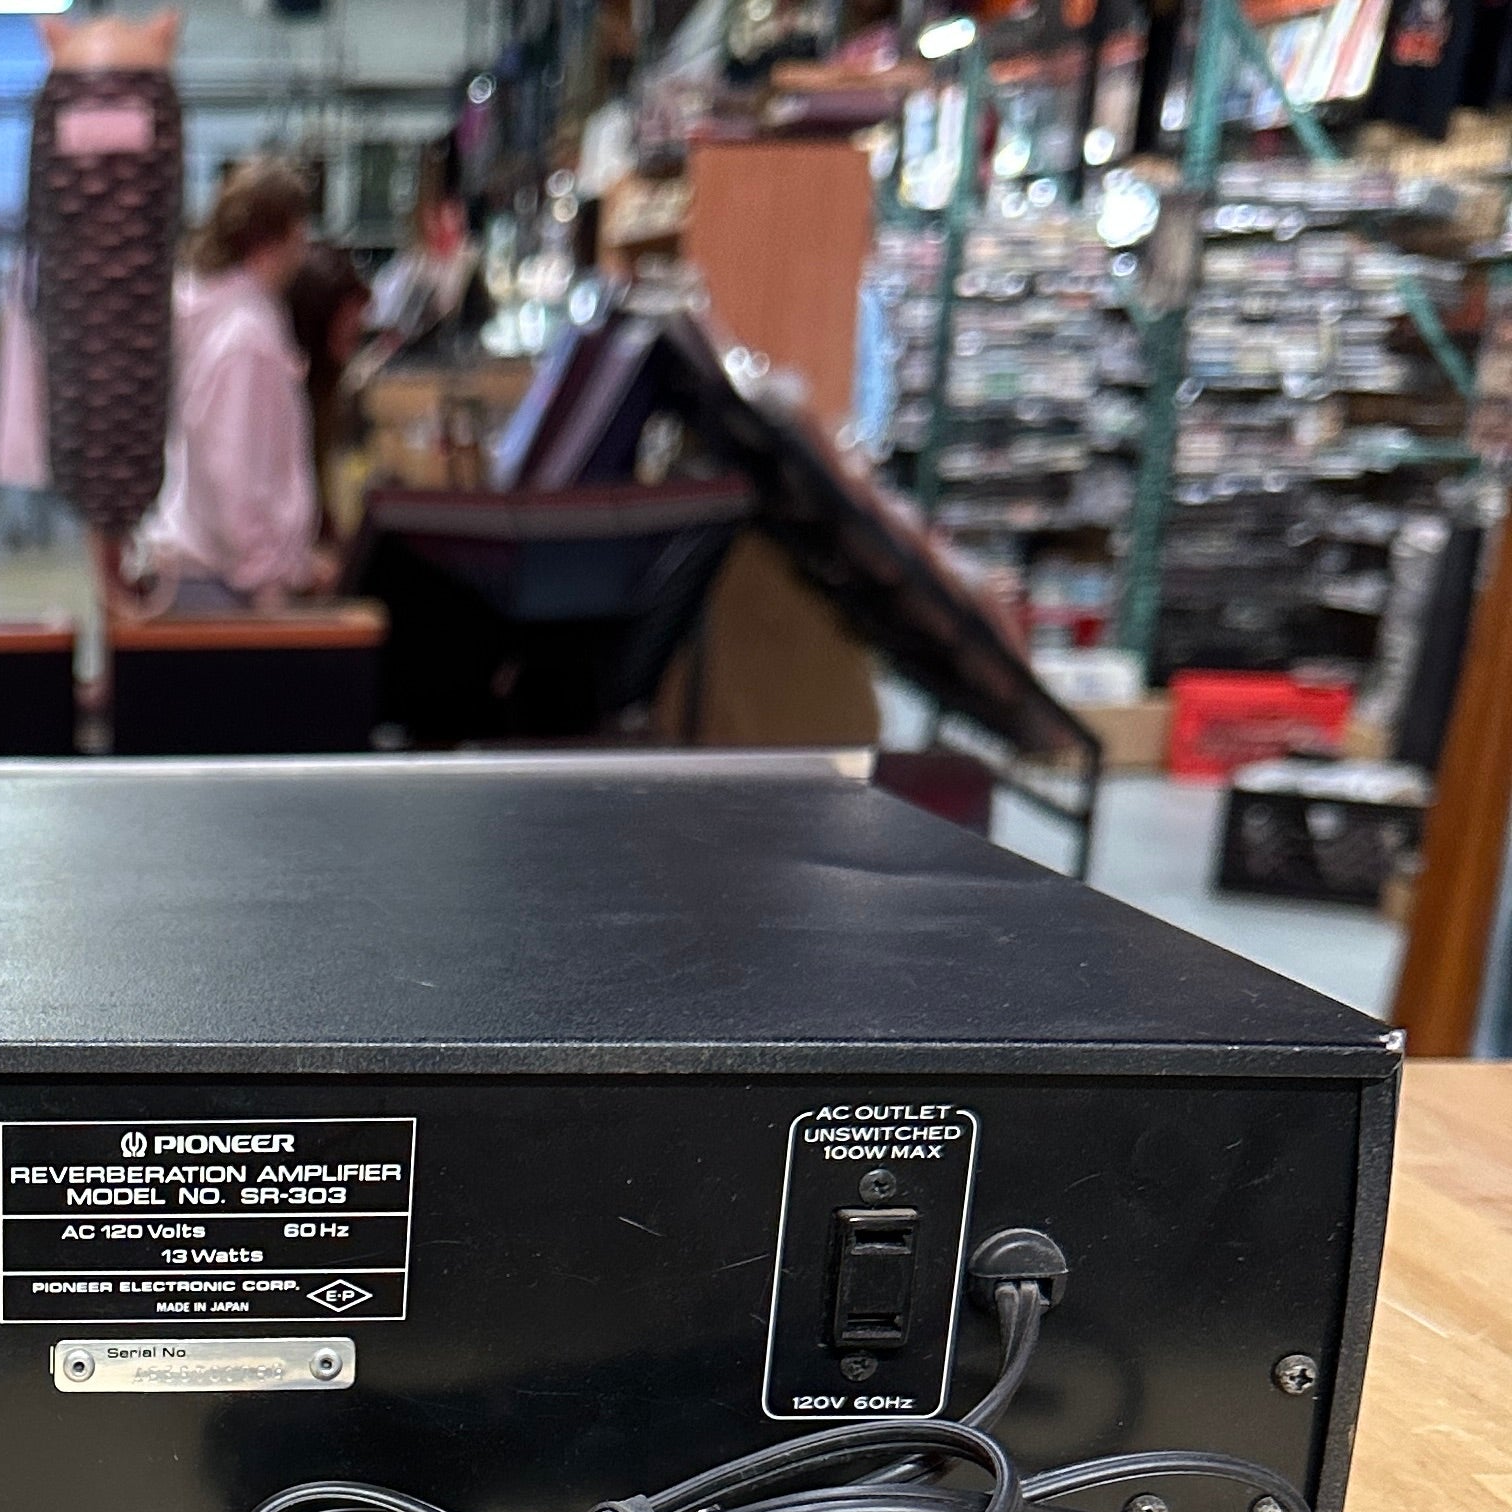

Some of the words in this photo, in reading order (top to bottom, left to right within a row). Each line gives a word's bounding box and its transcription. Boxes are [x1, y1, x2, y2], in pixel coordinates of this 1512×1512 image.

[816, 1105, 850, 1120] AC
[855, 1105, 952, 1120] OUTLET
[804, 1126, 962, 1141] UNSWITCHED
[154, 1134, 295, 1154] PIONEER
[824, 1146, 888, 1160] 100W
[891, 1146, 943, 1159] MAX
[10, 1166, 247, 1185] REVERBERATION
[257, 1164, 402, 1182] AMPLIFIER
[67, 1188, 166, 1205] MODEL
[178, 1188, 226, 1205] NO.
[240, 1187, 347, 1205] SR-303
[61, 1225, 96, 1240] AC
[100, 1224, 142, 1240] 120
[146, 1223, 206, 1239] Volts
[283, 1223, 317, 1238] 60
[320, 1223, 349, 1238] Hz
[161, 1249, 187, 1264] 13
[190, 1248, 264, 1263] Watts
[31, 1281, 114, 1294] PIONEER
[119, 1281, 236, 1293] ELECTRONIC
[241, 1280, 300, 1292] CORP.
[156, 1301, 192, 1313] MADE
[193, 1302, 208, 1313] IN
[209, 1301, 249, 1313] JAPAN
[107, 1346, 157, 1359] Serial
[792, 1396, 846, 1410] 120V
[853, 1396, 914, 1410] 60Hz
